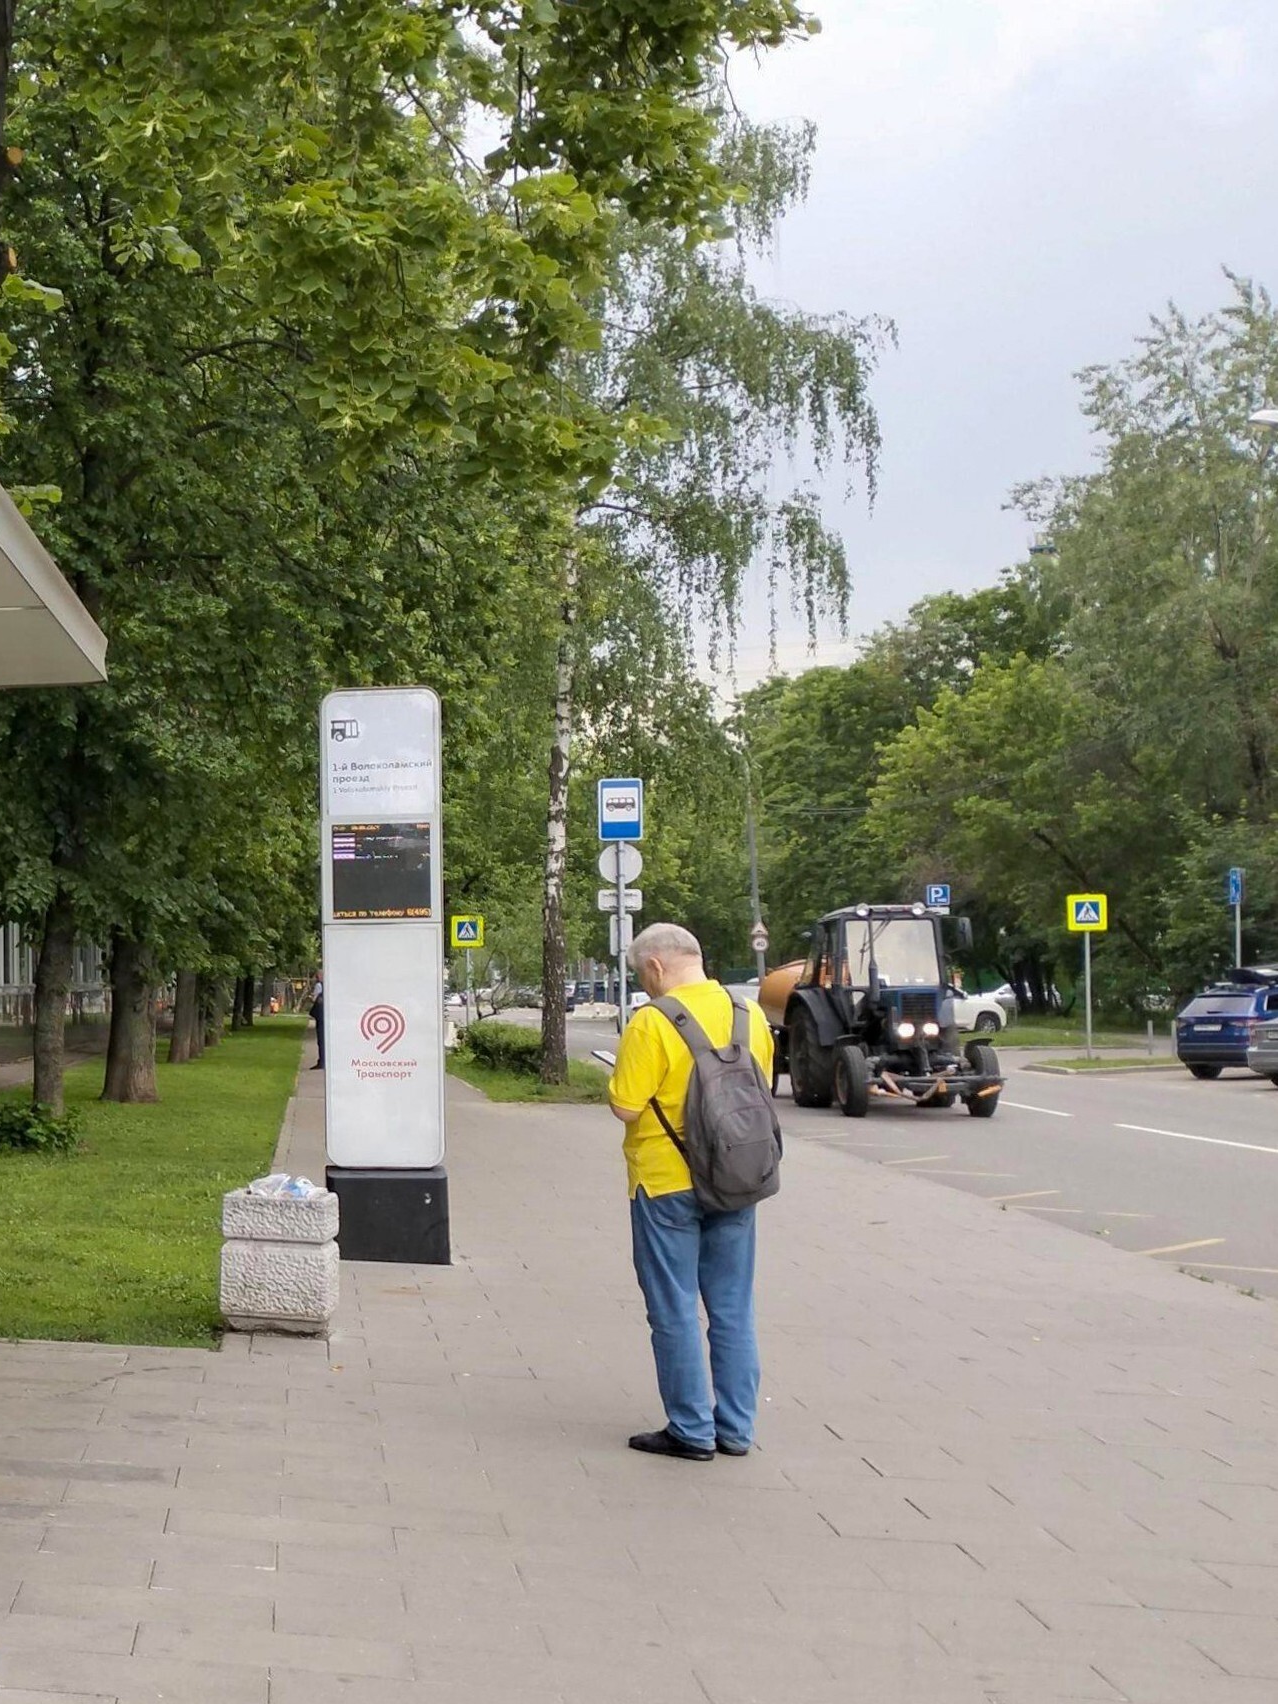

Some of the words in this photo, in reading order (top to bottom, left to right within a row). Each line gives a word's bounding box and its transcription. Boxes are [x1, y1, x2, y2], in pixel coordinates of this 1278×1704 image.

[332, 763, 348, 772] 1-й
[350, 759, 433, 771] Волоколамский
[332, 775, 370, 784] проезд
[931, 887, 943, 903] P
[351, 1058, 417, 1067] Московский
[356, 1069, 412, 1080] Транспорт
